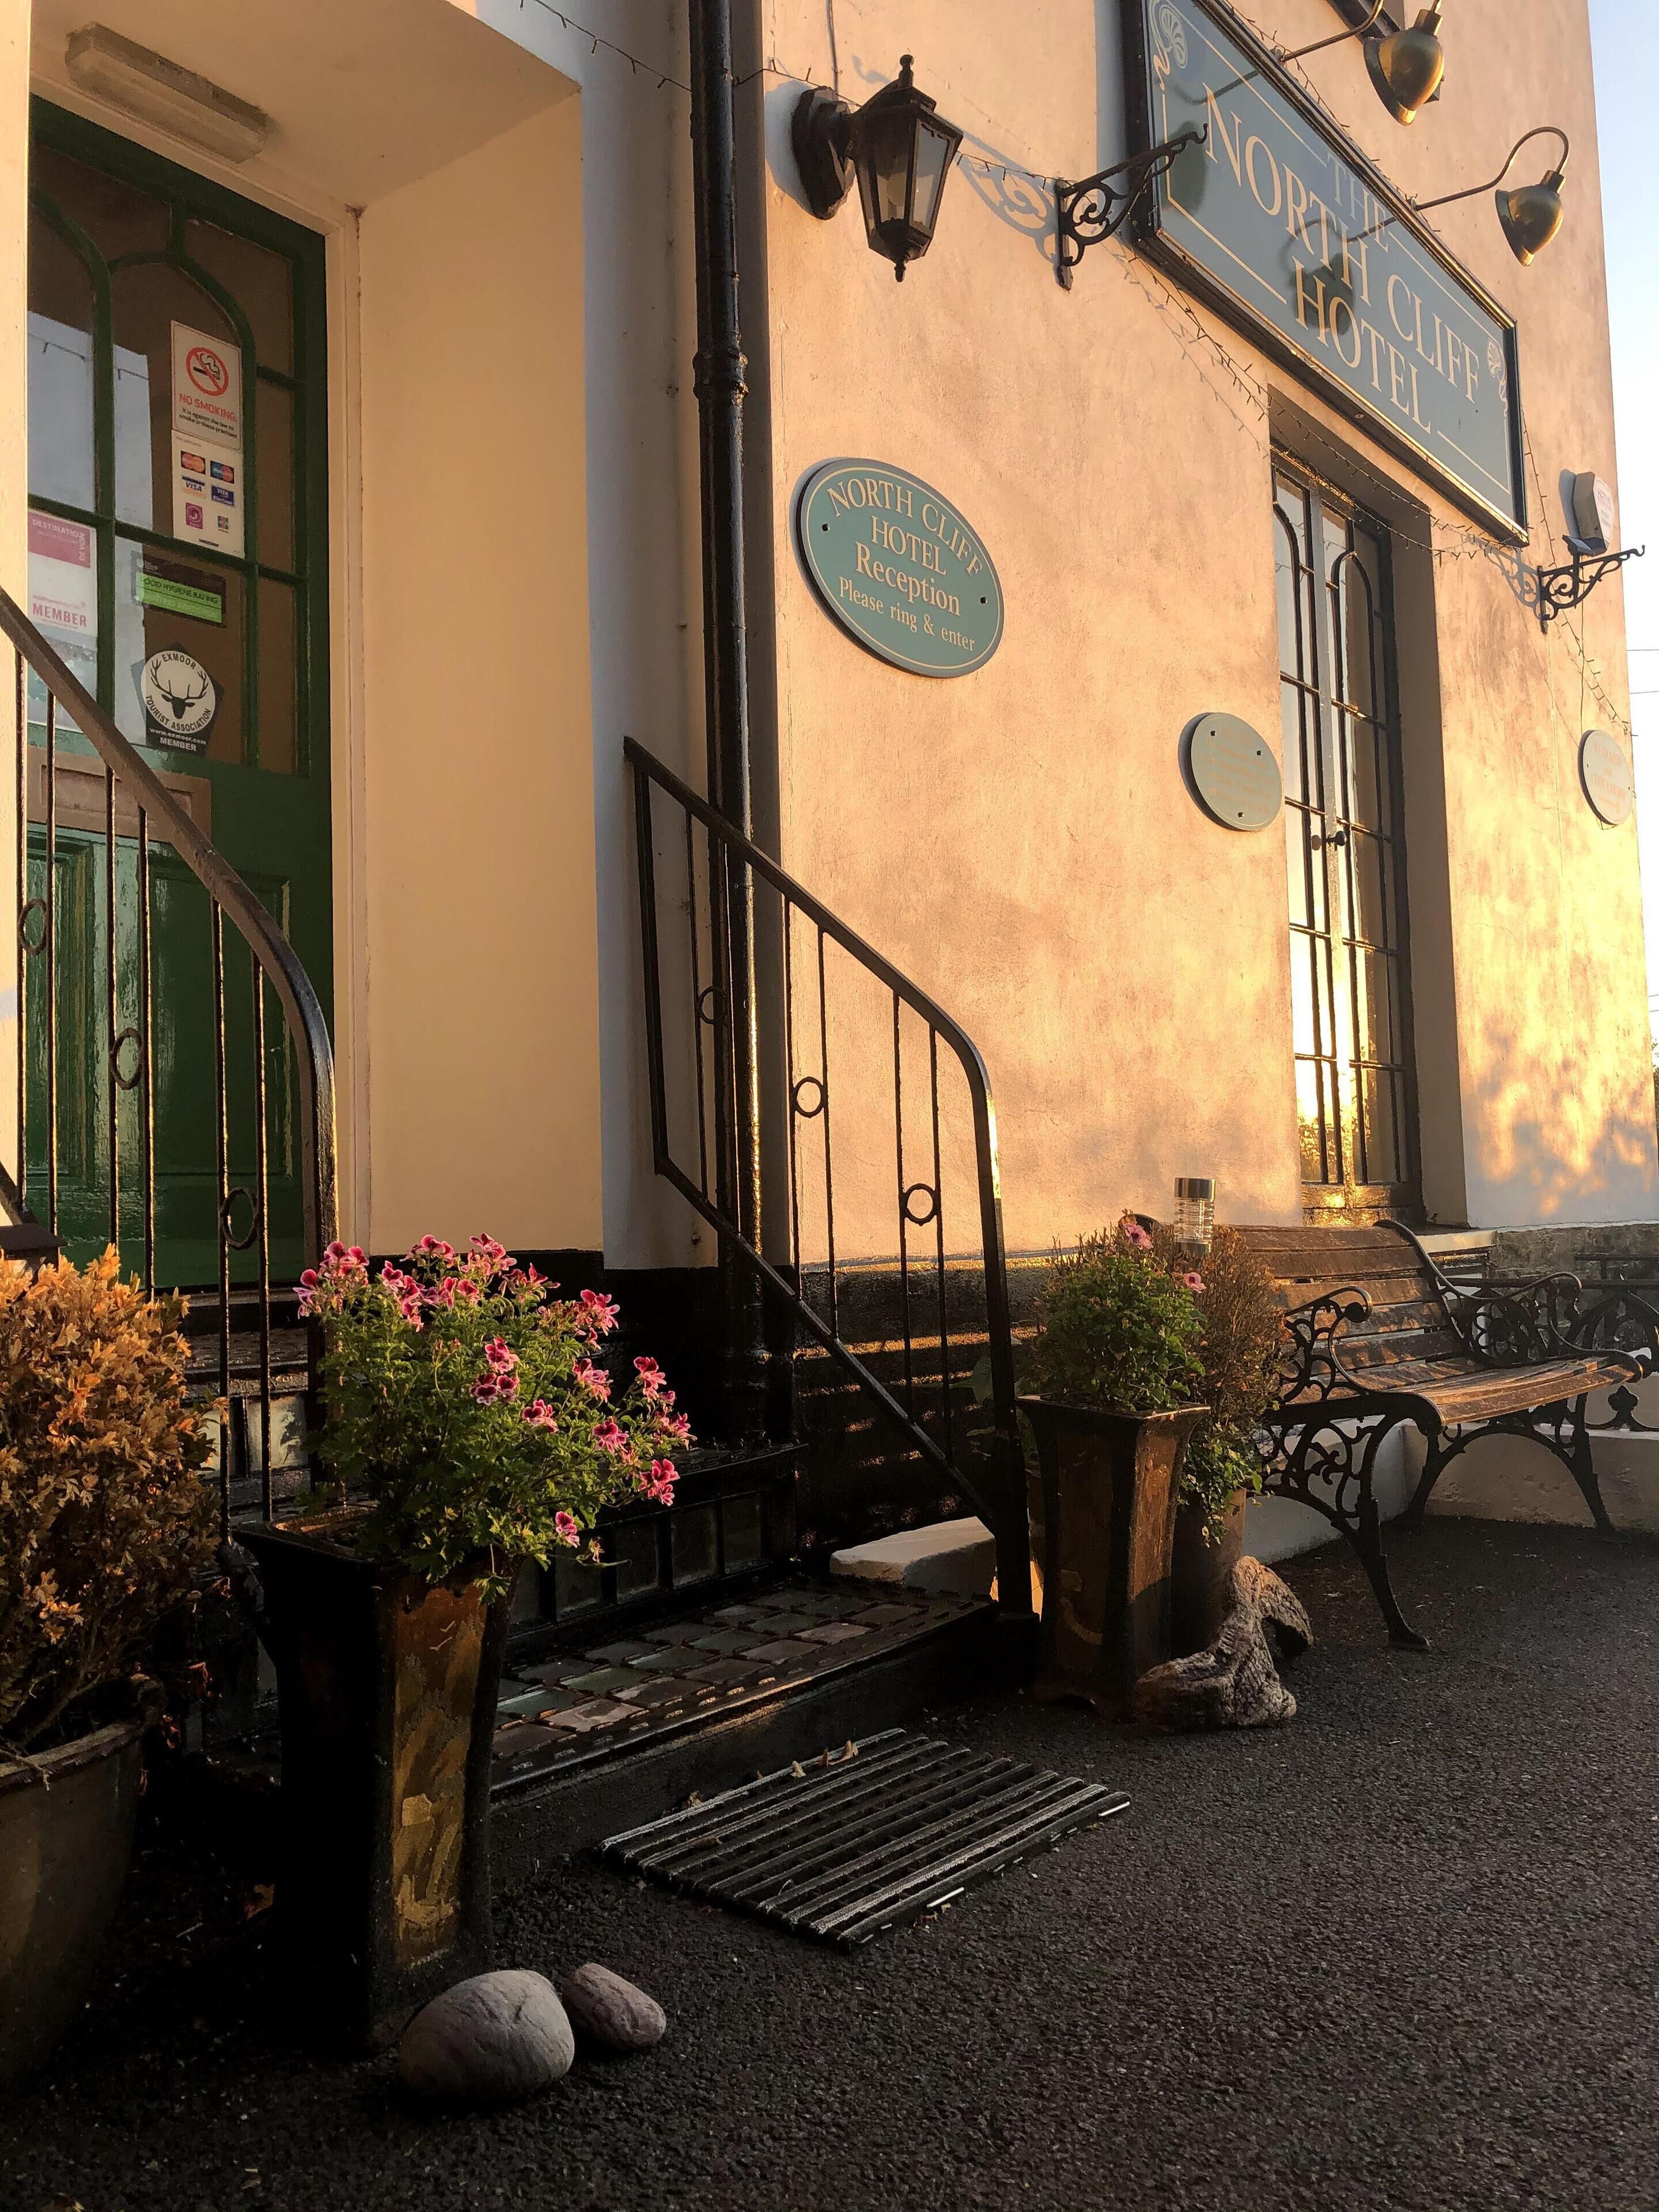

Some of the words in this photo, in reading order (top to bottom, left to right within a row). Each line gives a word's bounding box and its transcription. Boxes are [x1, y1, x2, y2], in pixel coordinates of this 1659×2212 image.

[1327, 153, 1389, 252] THE
[1203, 82, 1372, 307] NORTH
[1387, 274, 1480, 403] CLIFF
[1292, 256, 1431, 434] HOTEL
[179, 393, 192, 405] NO
[186, 482, 202, 492] VISA
[827, 478, 912, 518] NORTH
[922, 503, 983, 575] CLIFF
[871, 515, 946, 575] HOTEL
[855, 541, 961, 616] Reception
[33, 603, 86, 627] MEMBER
[839, 577, 884, 614] Please
[890, 603, 917, 632] ring
[923, 613, 935, 636] &
[941, 627, 975, 652] enter
[162, 652, 196, 669] EXMOOR
[146, 695, 170, 725] TOURIST
[171, 707, 212, 732] ASSOCIATION
[149, 728, 207, 745] www.exmoor.com
[160, 737, 197, 752] MEMBER
